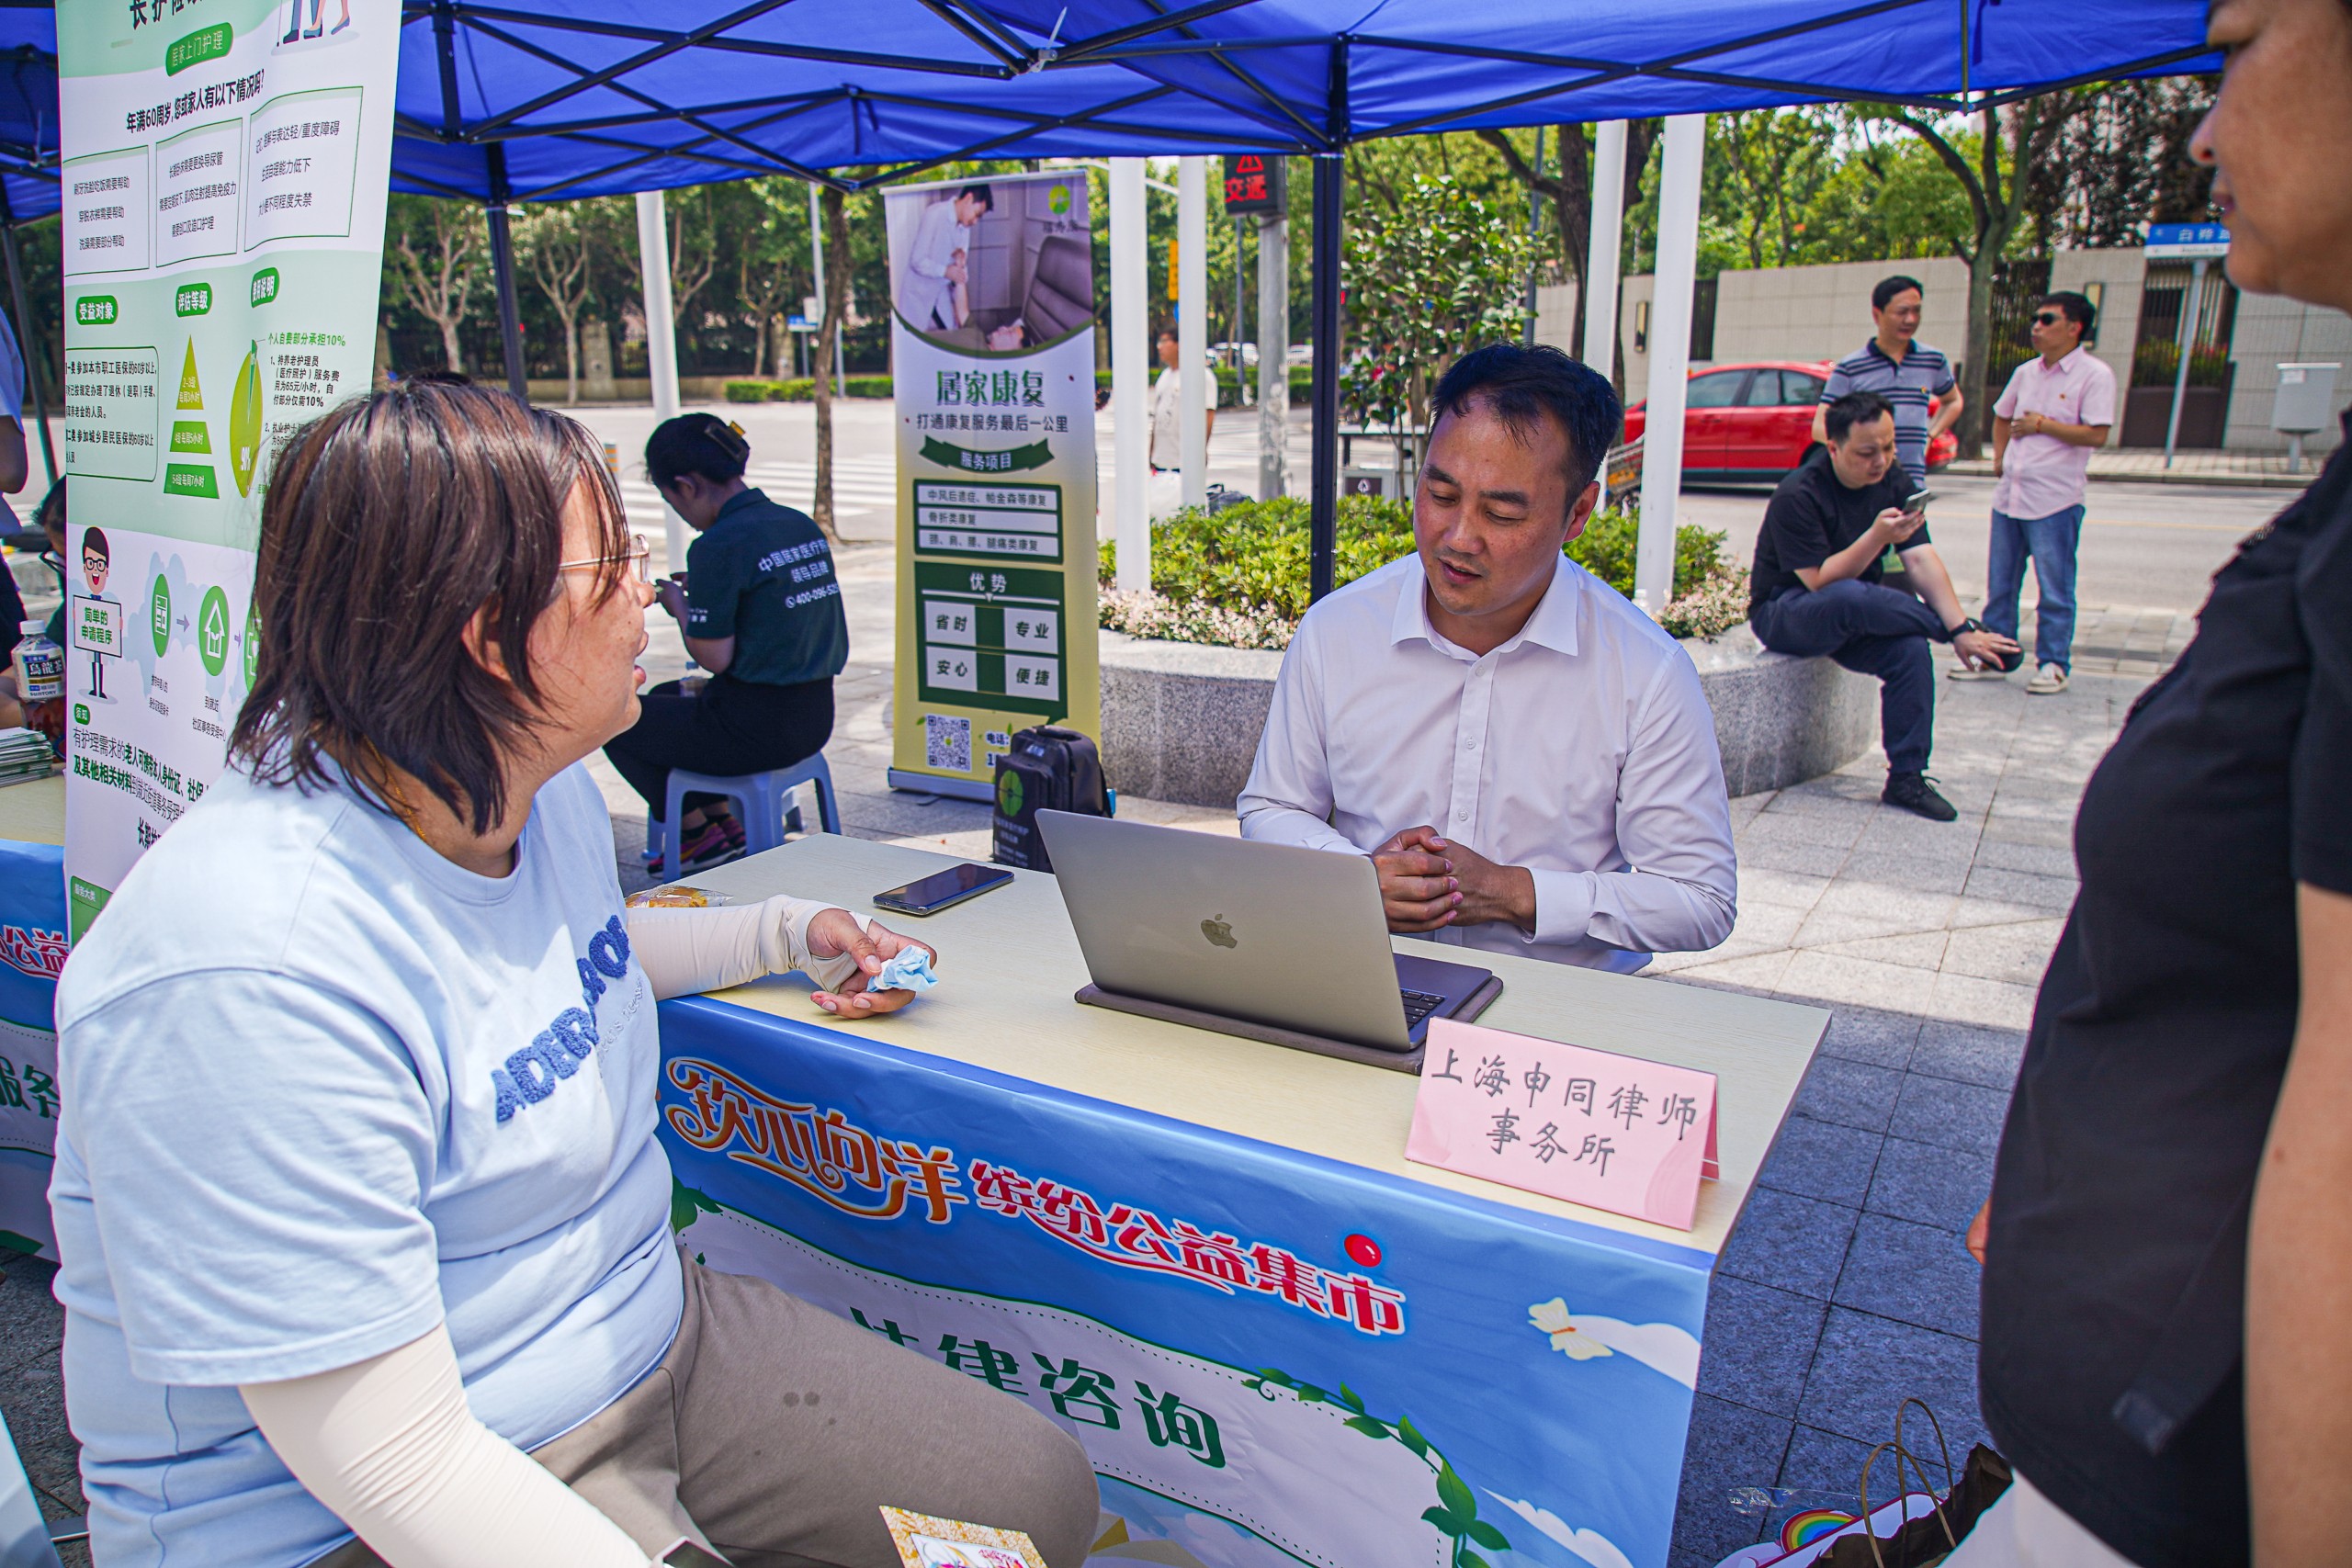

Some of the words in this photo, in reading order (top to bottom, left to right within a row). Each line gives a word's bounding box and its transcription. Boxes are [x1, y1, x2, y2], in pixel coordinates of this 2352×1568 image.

[172, 30, 223, 68] 居家上门护理
[252, 276, 276, 302] 费用说明
[177, 289, 209, 312] 评估等级
[79, 302, 115, 321] 受益对象
[268, 332, 346, 347] 个人自费部分承担10%
[936, 370, 1046, 407] 居家康复
[273, 395, 324, 408] 付部分仅需10%
[916, 413, 1069, 433] 打通康复服务最后一公里
[961, 451, 1012, 470] 服务项目
[927, 490, 1046, 506] 中风后遗症、帕金森等康复
[929, 513, 976, 526] 骨折类康复
[969, 572, 1007, 593] 优势
[85, 605, 108, 626] 简单的
[936, 615, 967, 632] 省时
[81, 624, 113, 646] 申请程序
[1015, 621, 1050, 638] 专业
[937, 660, 967, 677] 安心
[1016, 668, 1050, 686] 便捷
[75, 706, 89, 723] 须知
[74, 727, 209, 802] 有护理需求的老人可携带本人身份证、社保
[74, 884, 96, 902] 服务大类
[0, 925, 69, 976] 公益
[1431, 1048, 1696, 1141] 上海申同律师
[1487, 1107, 1614, 1177] 事务所
[968, 1159, 1405, 1334] 缤纷公益集市
